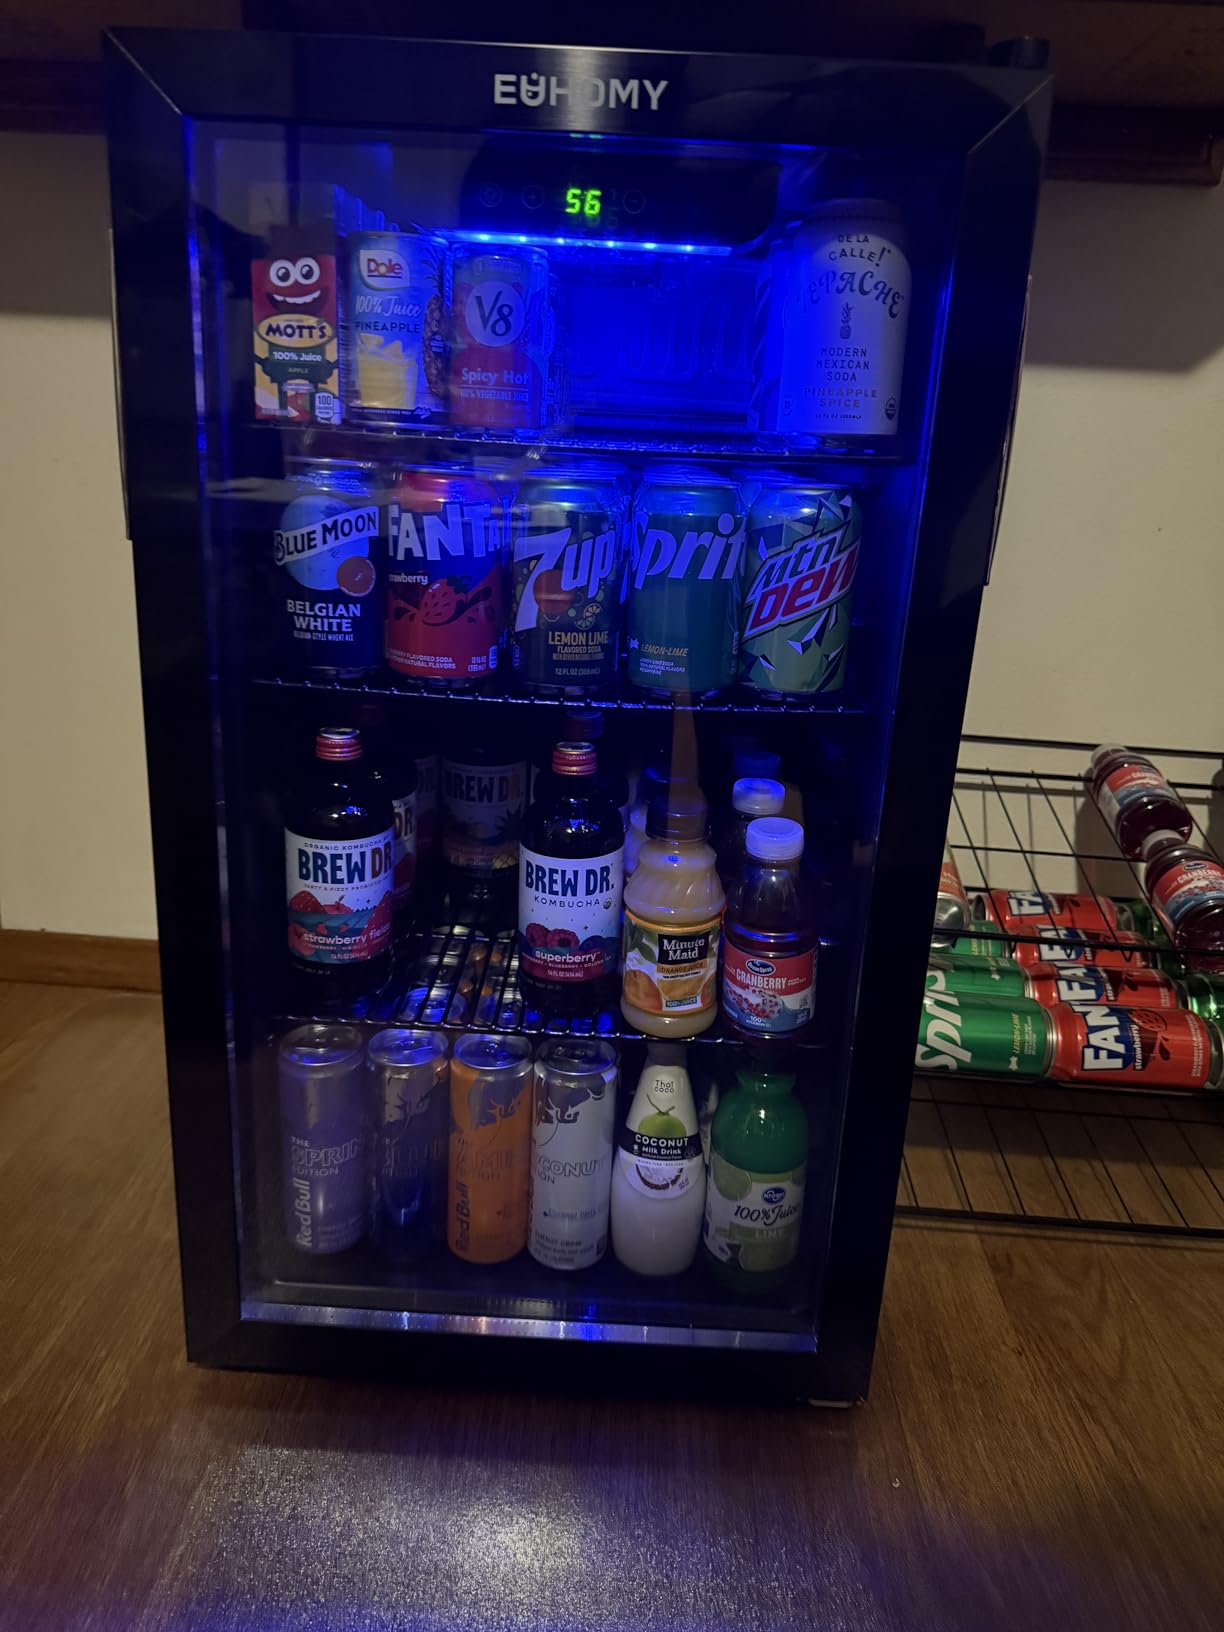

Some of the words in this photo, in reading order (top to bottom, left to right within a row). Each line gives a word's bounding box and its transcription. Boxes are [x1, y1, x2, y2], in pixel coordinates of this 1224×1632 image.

[493, 72, 670, 111] EUHOMY
[565, 186, 602, 217] 56
[838, 235, 853, 243] DE
[857, 235, 870, 243] LA
[367, 258, 402, 274] Dole
[800, 270, 905, 319] EPACHE
[355, 296, 383, 316] 100%
[383, 296, 422, 316] Juice
[475, 290, 513, 336] V8
[354, 320, 421, 334] PINEAPPLE
[272, 351, 299, 361] 100%
[299, 352, 323, 362] Juice
[821, 347, 867, 357] MODERN
[816, 360, 870, 370] MEXICAN
[461, 367, 498, 385] Spicy
[503, 369, 528, 385] Hot
[827, 371, 857, 381] SODA
[804, 386, 878, 398] PINEAPPLE
[318, 395, 332, 405] 100
[819, 399, 861, 408] SPICE
[275, 529, 317, 563] BLUE
[321, 511, 377, 546] MOON
[287, 599, 361, 617] BELGIAN
[293, 615, 353, 632] WHITE
[548, 631, 587, 646] LEMON
[588, 630, 609, 645] LIME
[557, 645, 587, 654] FLAVORED
[640, 644, 689, 657] LEMON-LIME
[428, 661, 456, 670] FLAVORS
[304, 843, 339, 851] ORGANIC
[298, 848, 366, 885] BREW
[526, 860, 579, 897] BREW
[585, 866, 615, 896] DR.
[534, 896, 600, 908] KOMBUCHA
[303, 933, 367, 946] strawberry
[663, 938, 705, 951] Minute
[535, 951, 597, 963] superberry
[668, 947, 699, 961] Maid
[661, 966, 687, 974] ORANGE
[687, 962, 703, 971] JUICE
[736, 968, 787, 990] CRANBERRY
[1130, 1024, 1143, 1070] strawberry
[290, 1136, 310, 1148] THE
[635, 1134, 689, 1148] COCONUT
[642, 1146, 658, 1155] Milk
[660, 1147, 682, 1156] Drink
[293, 1177, 312, 1211] Bull
[734, 1204, 771, 1222] 100%
[296, 1211, 313, 1247] Red
